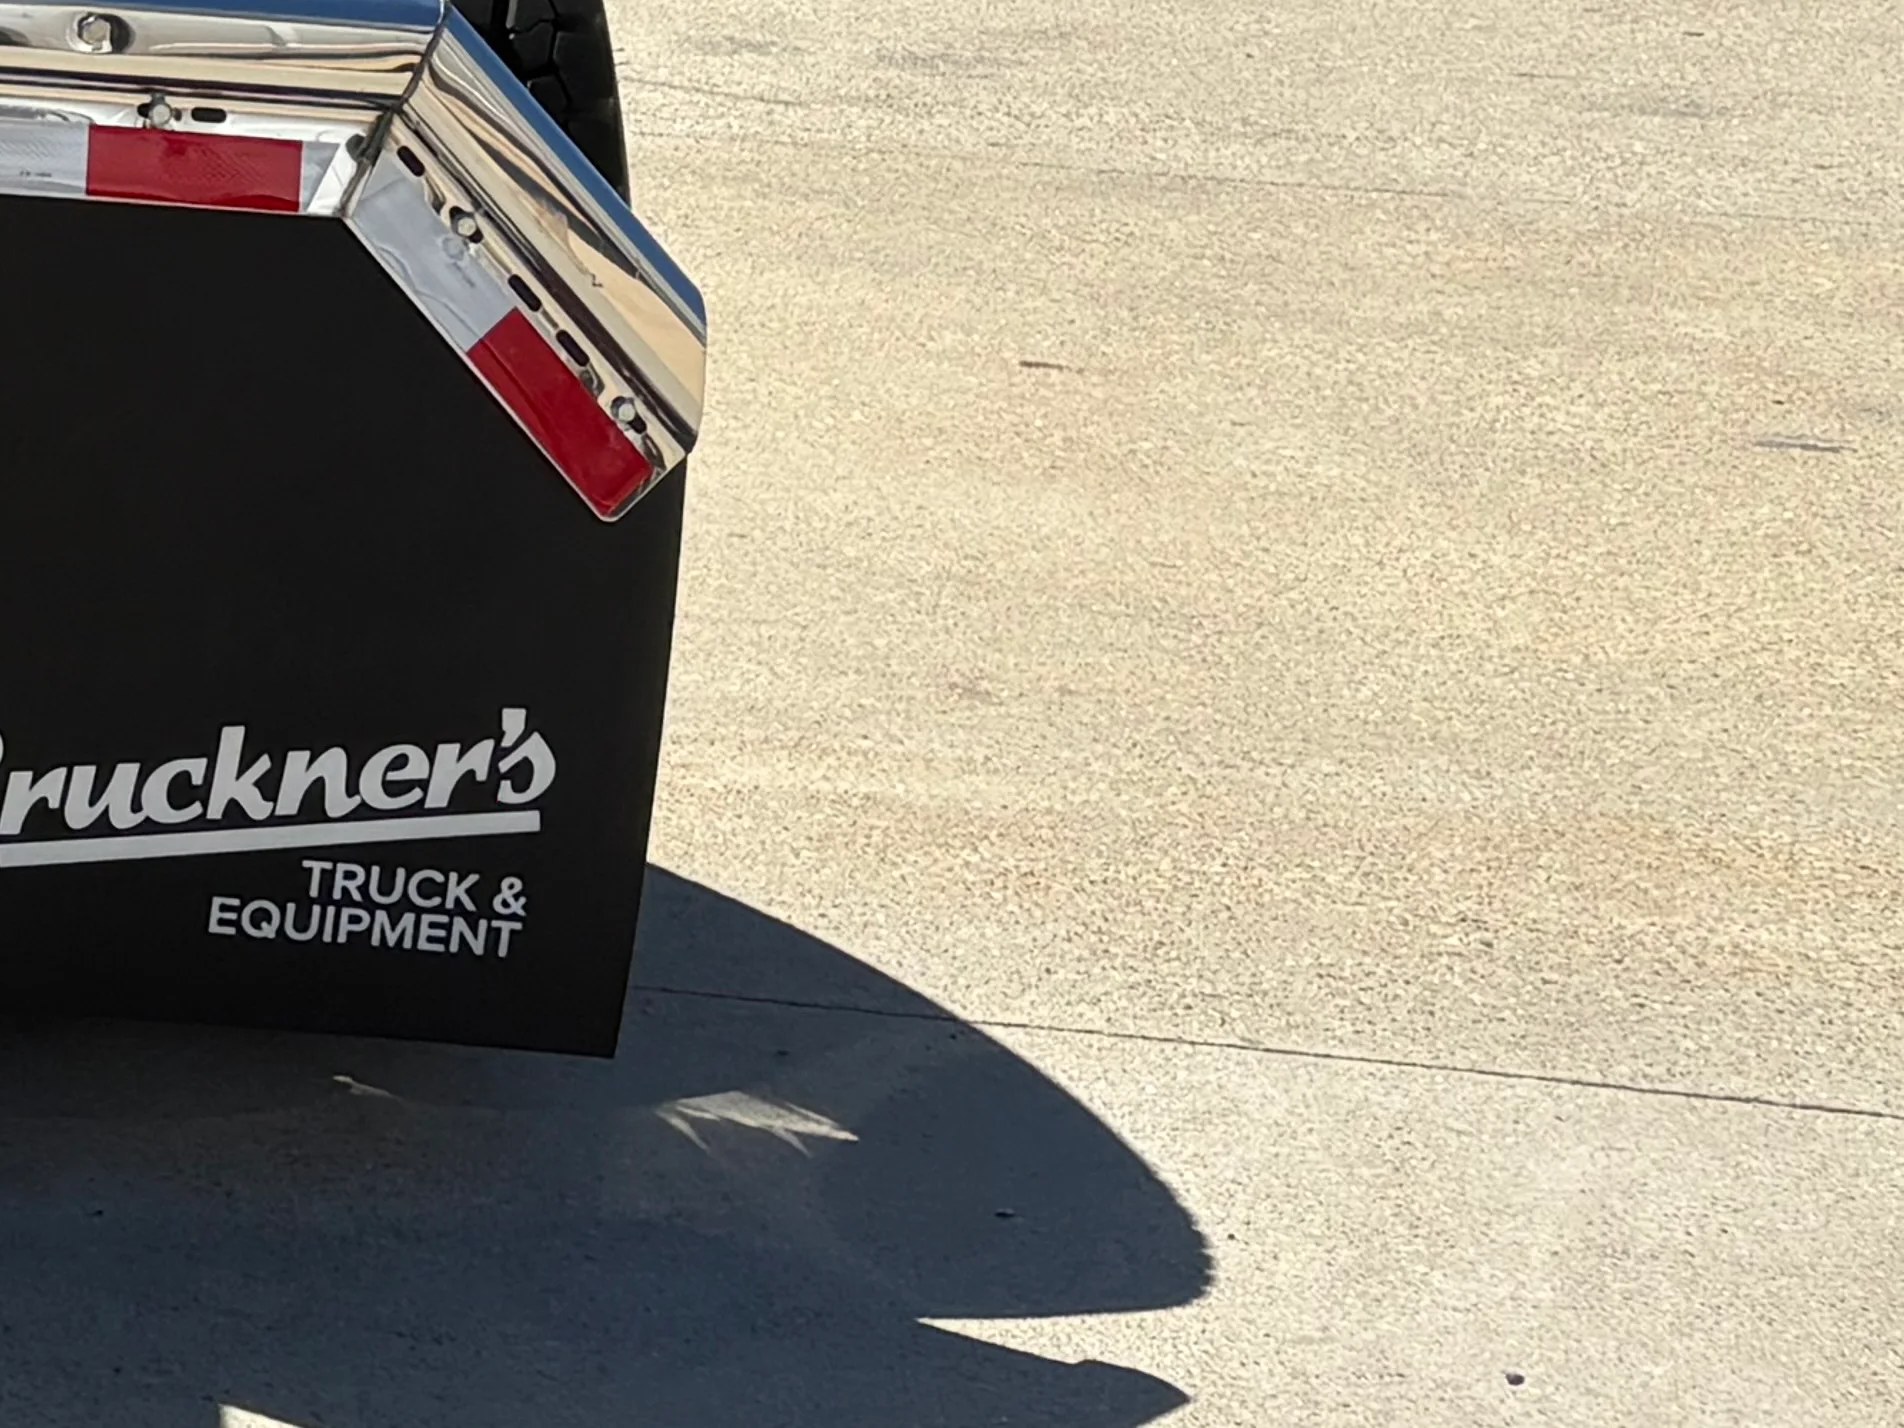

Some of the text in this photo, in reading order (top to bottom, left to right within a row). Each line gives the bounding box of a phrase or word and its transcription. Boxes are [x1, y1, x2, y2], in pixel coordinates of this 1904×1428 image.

[302, 859, 527, 917] TRUCK &
[208, 896, 523, 958] EQUIPMENT
